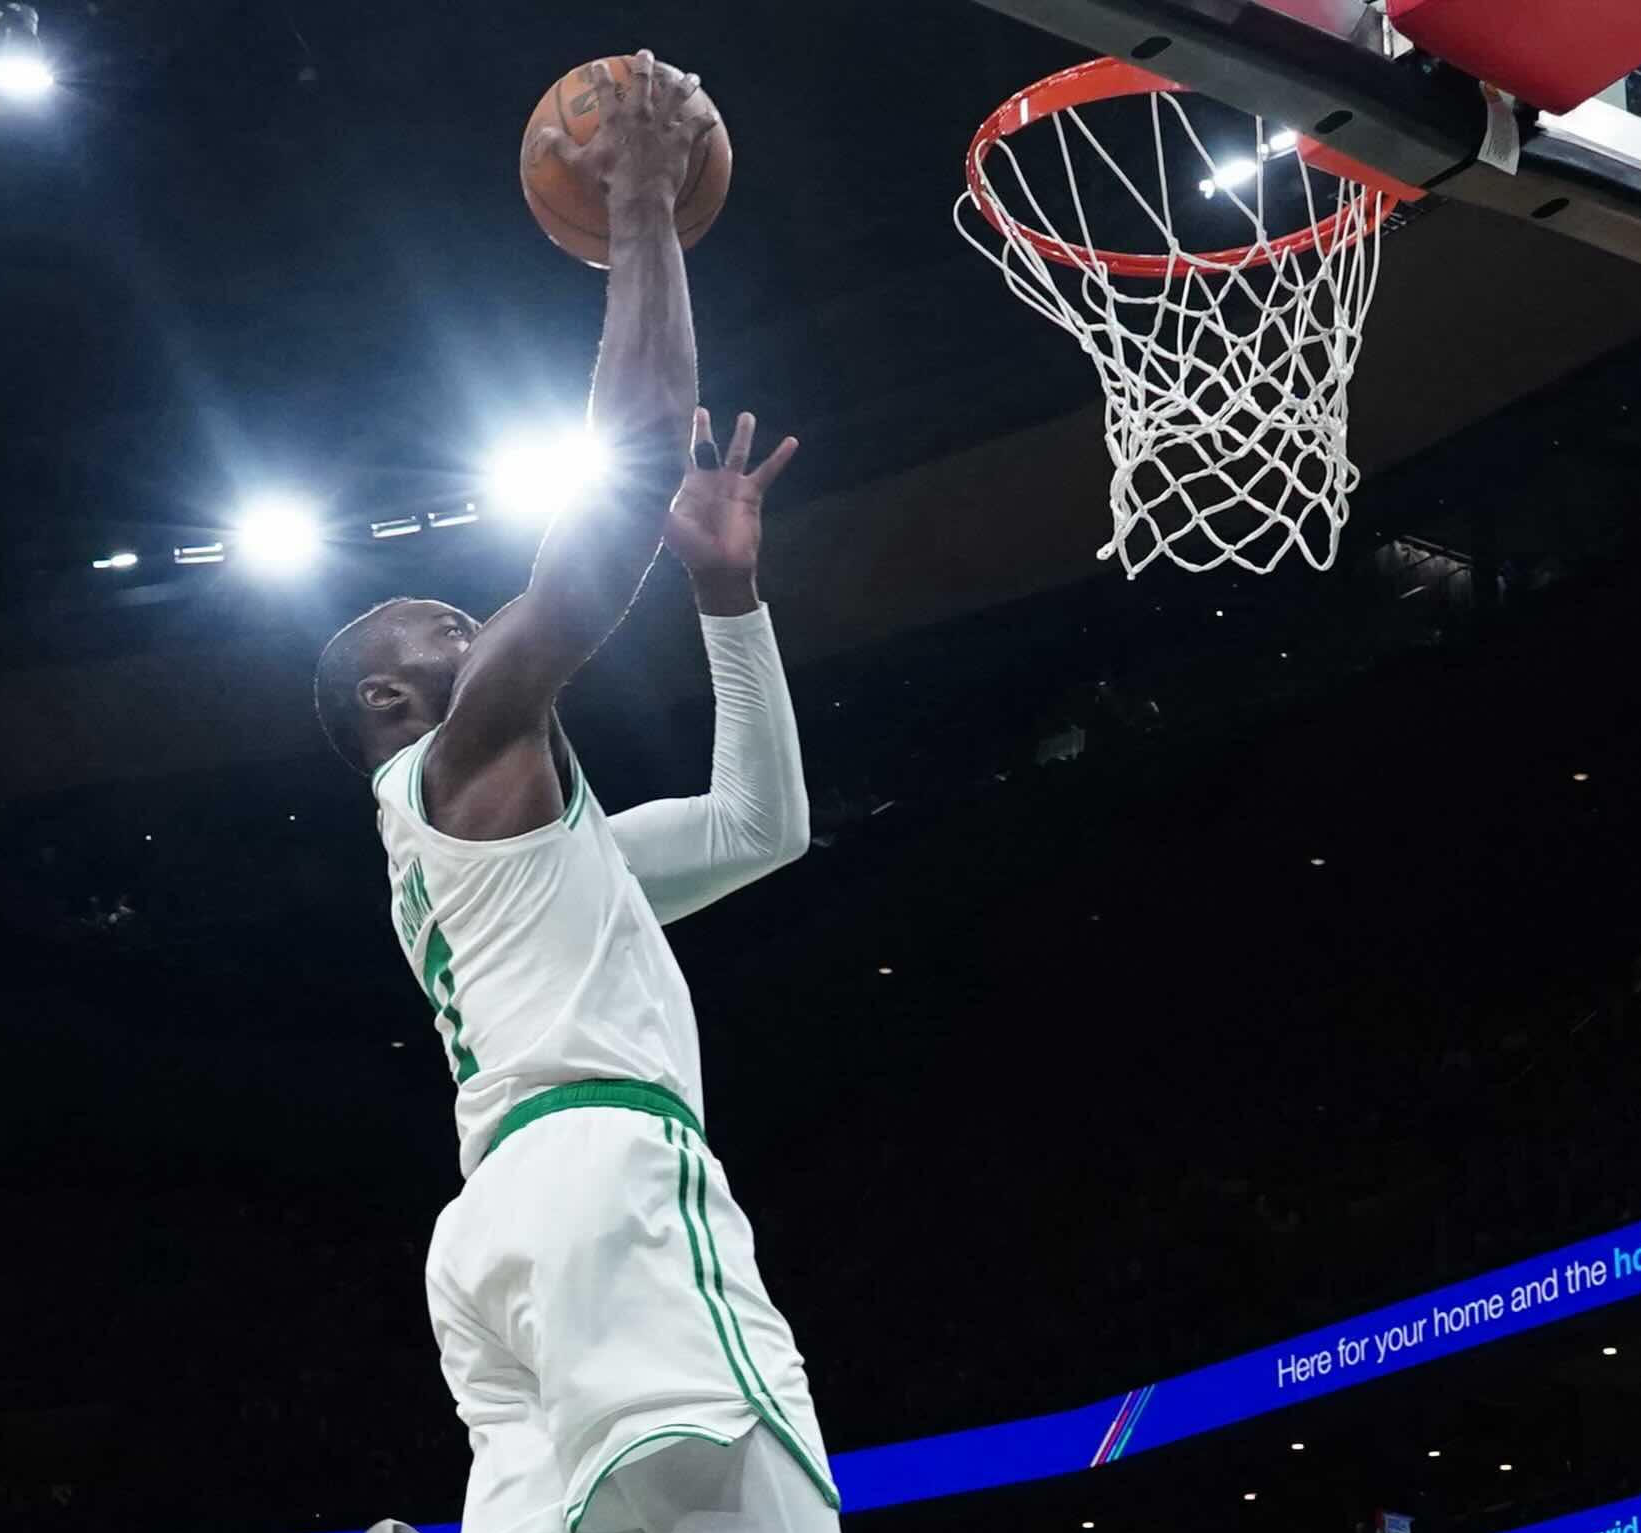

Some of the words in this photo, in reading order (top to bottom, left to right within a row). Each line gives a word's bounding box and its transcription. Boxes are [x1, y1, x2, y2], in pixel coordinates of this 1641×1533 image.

[1277, 1357, 1332, 1388] Here
[1337, 1336, 1368, 1369] for
[1374, 1316, 1427, 1361] your
[1433, 1291, 1504, 1338] home
[1510, 1268, 1560, 1313] and
[1565, 1257, 1607, 1296] the
